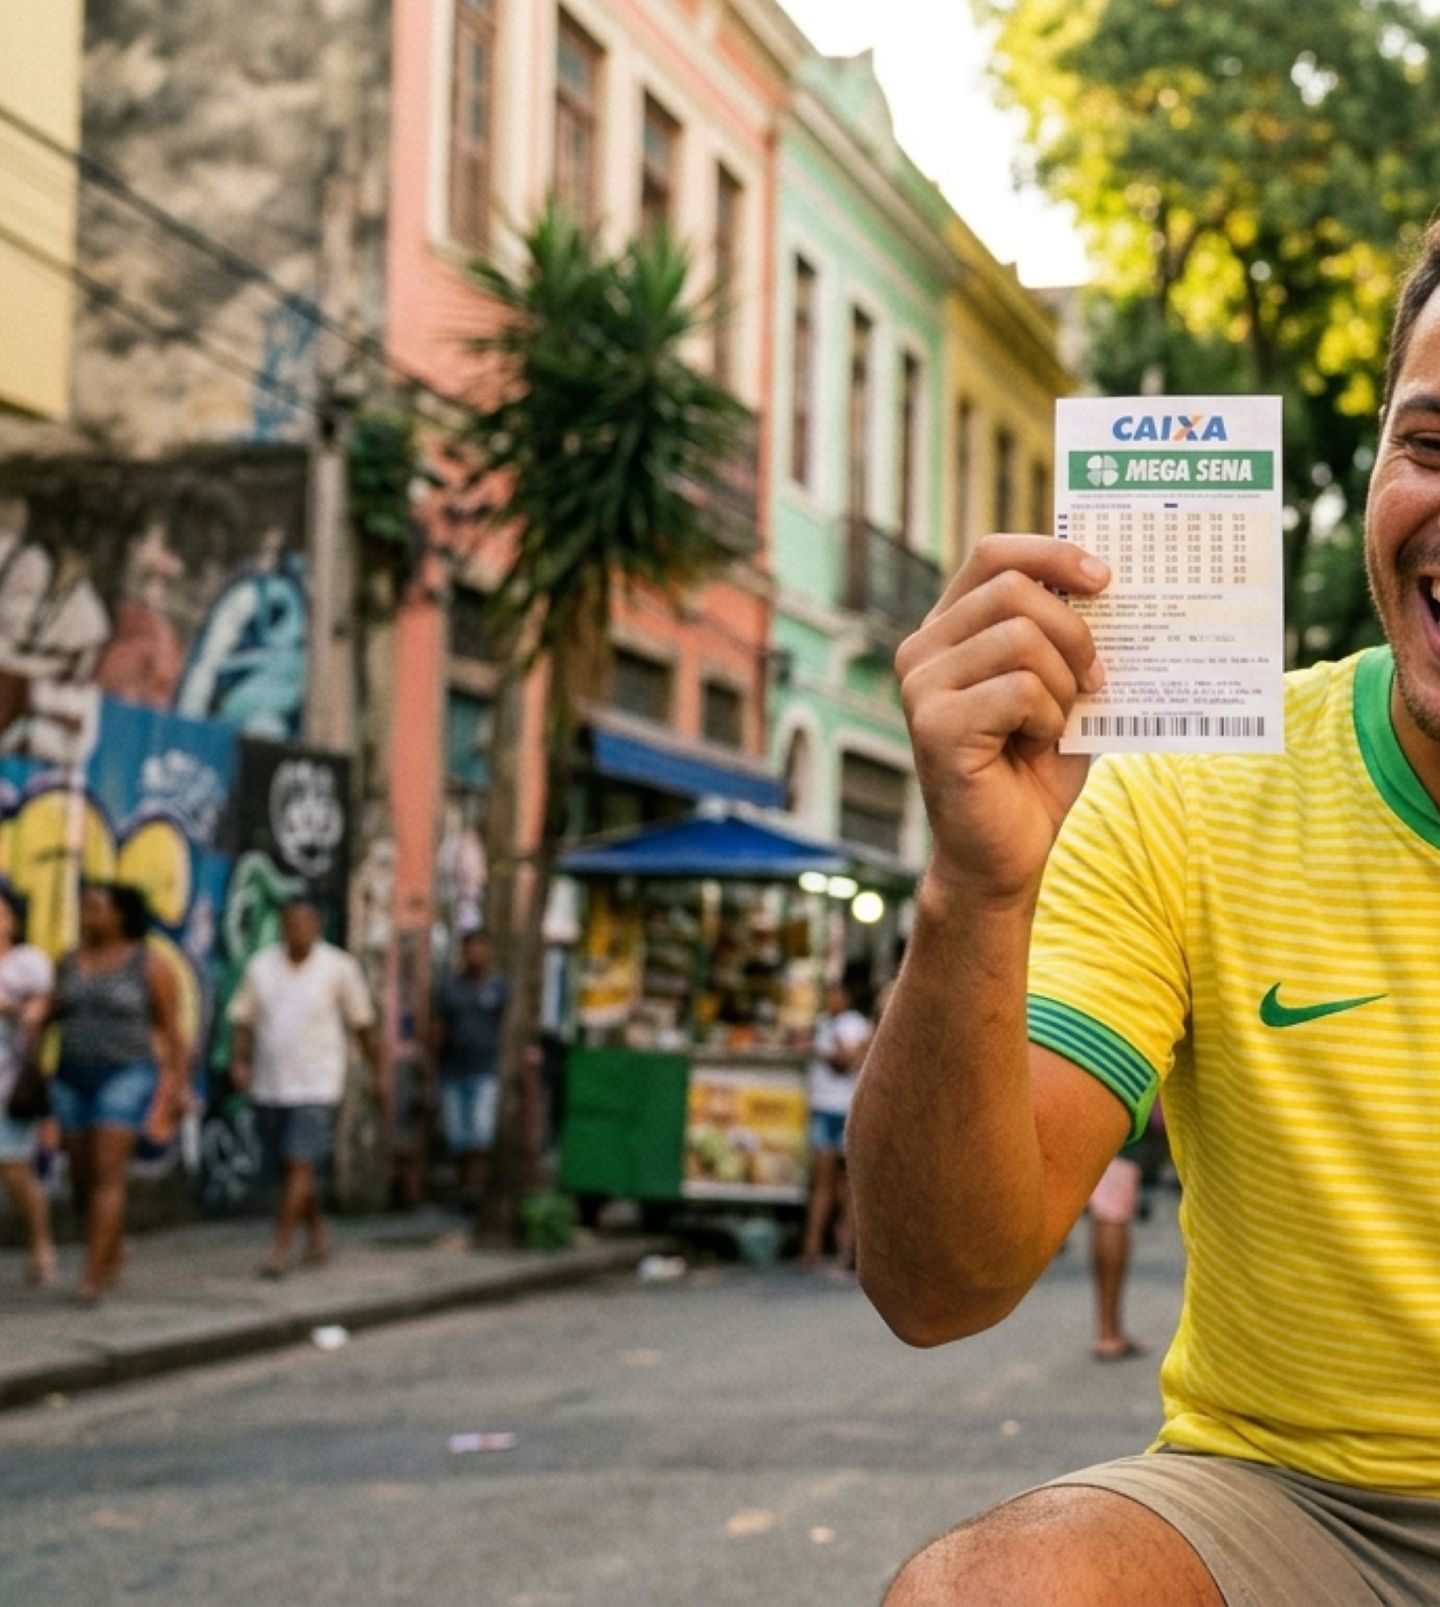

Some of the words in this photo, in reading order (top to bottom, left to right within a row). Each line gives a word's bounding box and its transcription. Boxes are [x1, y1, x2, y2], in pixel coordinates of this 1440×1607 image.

[1112, 415, 1228, 441] CAIXA
[1125, 459, 1191, 481] MEGA
[1196, 459, 1253, 481] SENA
